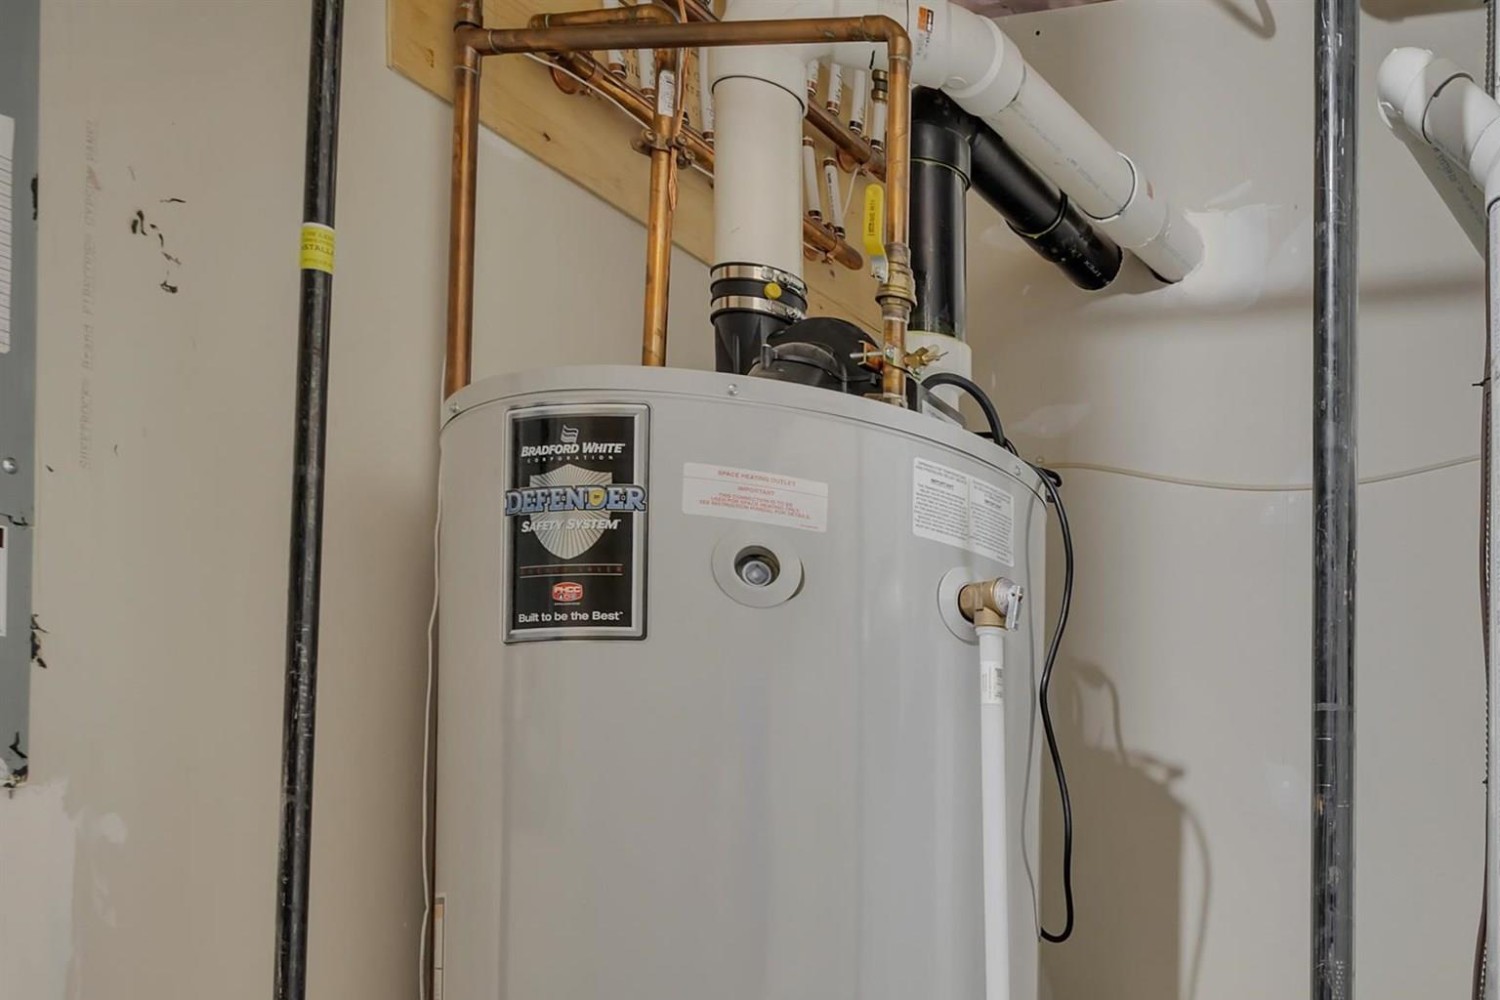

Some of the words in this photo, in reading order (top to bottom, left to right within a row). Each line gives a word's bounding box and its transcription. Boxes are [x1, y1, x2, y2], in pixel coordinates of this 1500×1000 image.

[521, 444, 579, 457] BRADFORD
[527, 455, 614, 463] CORPORATION
[718, 470, 739, 478] SPACE
[741, 474, 769, 482] HEATING
[771, 477, 796, 487] OUTLET
[738, 487, 775, 496] IMPORTANT
[505, 485, 647, 516] DEFENDER
[521, 520, 564, 532] SAFETY
[518, 614, 540, 623] Built
[541, 614, 552, 622] to
[554, 612, 568, 621] be
[570, 611, 589, 620] the
